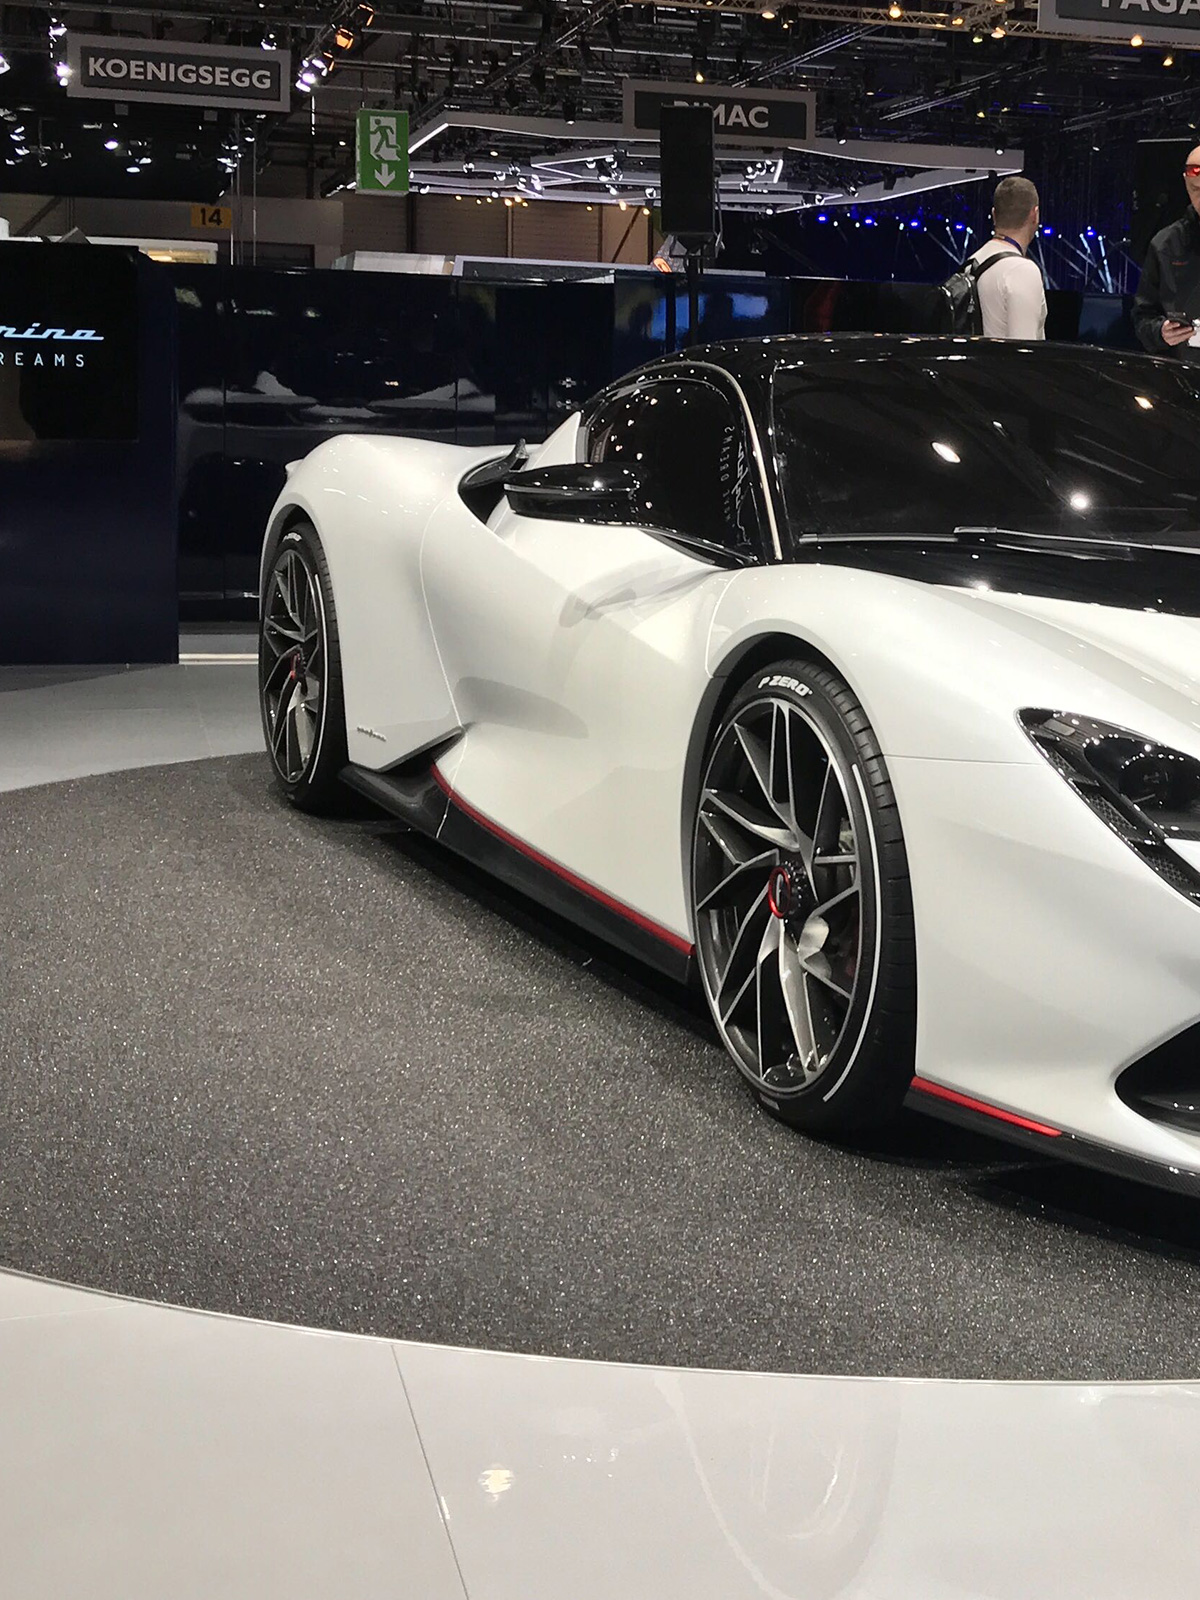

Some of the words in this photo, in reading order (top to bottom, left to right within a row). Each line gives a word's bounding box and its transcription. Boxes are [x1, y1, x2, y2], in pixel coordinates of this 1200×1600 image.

[88, 57, 271, 89] KOENIGSEGG
[673, 100, 769, 129] MAC
[200, 207, 222, 226] 14
[769, 675, 811, 697] ZERO
